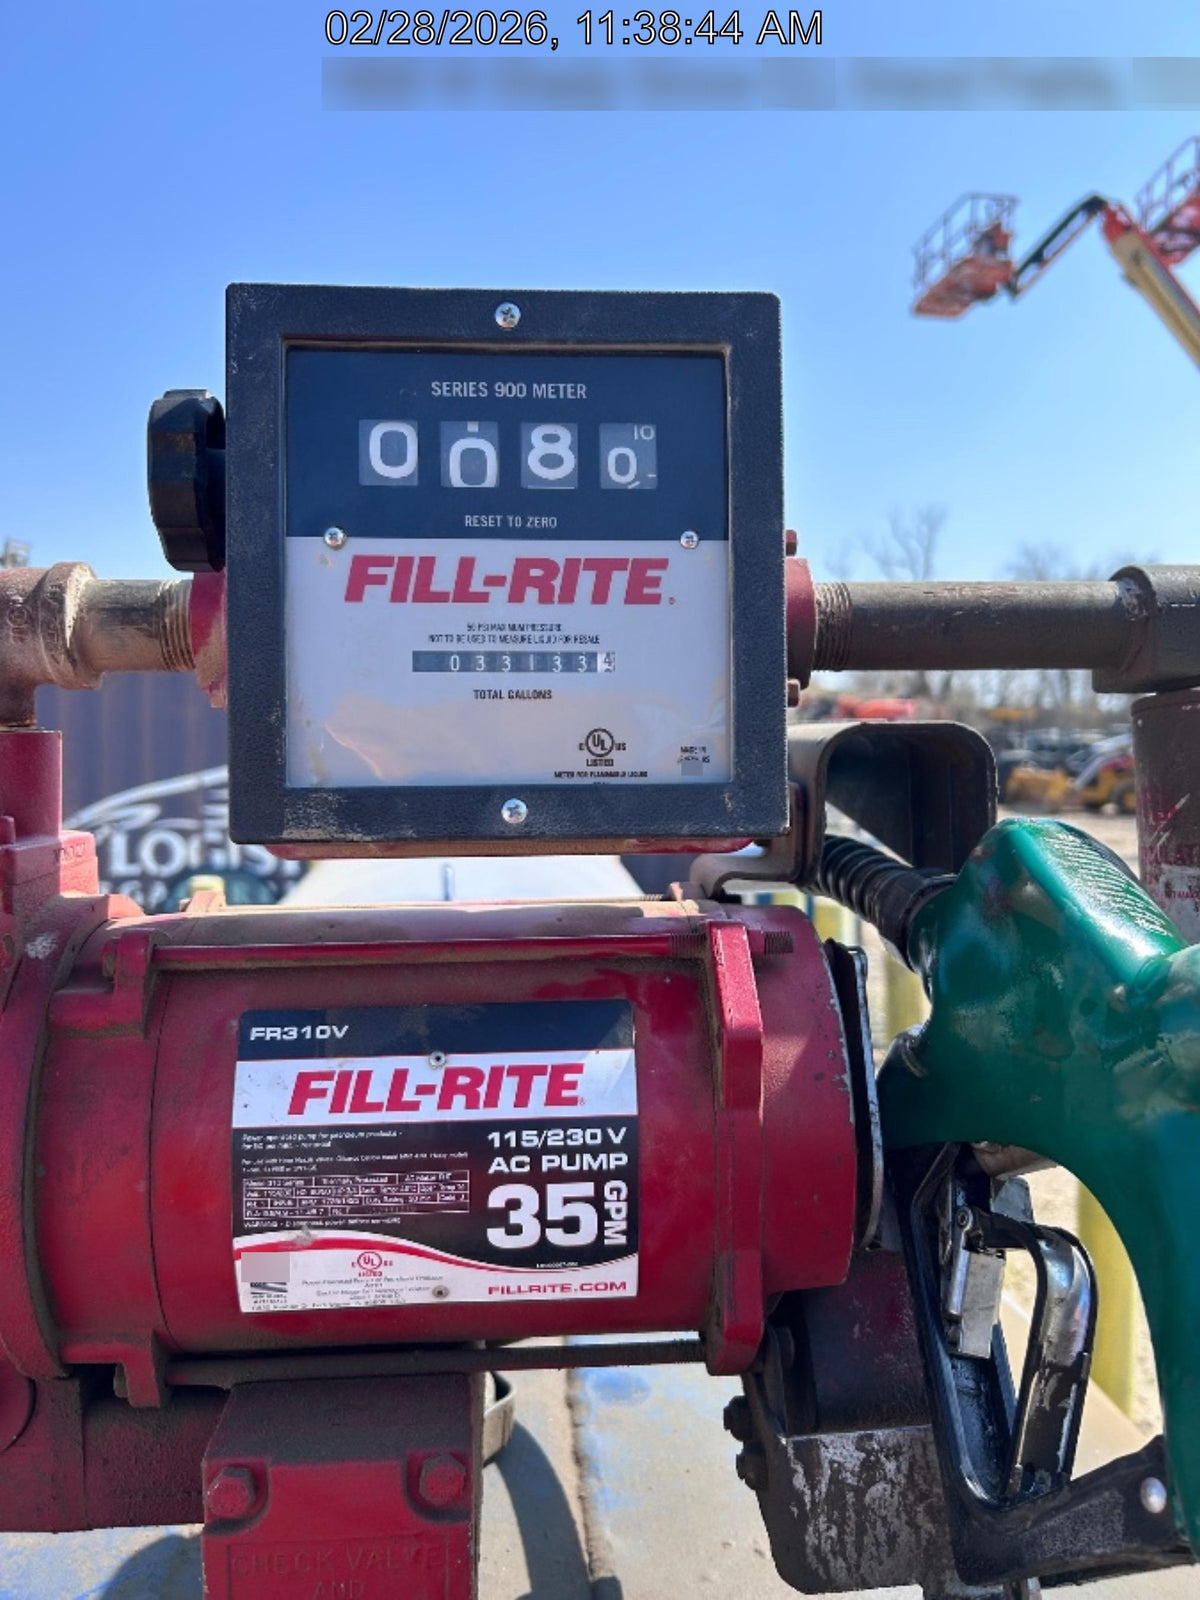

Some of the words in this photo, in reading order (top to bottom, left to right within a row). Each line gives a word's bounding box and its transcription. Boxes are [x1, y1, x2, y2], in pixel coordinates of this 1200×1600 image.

[431, 381, 488, 398] SERIES
[495, 381, 527, 398] 900
[532, 383, 587, 399] METER
[464, 514, 502, 528] RESET
[508, 515, 523, 528] TO
[526, 515, 558, 529] ZERO
[344, 554, 670, 605] FILL-RITE
[473, 689, 503, 700] TOTAL
[507, 689, 553, 700] GALLONS
[586, 758, 614, 767] LISTED
[249, 1024, 349, 1042] FR310V
[287, 1062, 585, 1116] FILL-RITE
[487, 1127, 603, 1149] 115/230
[606, 1126, 628, 1145] V
[488, 1154, 531, 1175] AC
[541, 1152, 629, 1173] PUMP
[486, 1181, 599, 1249] 35
[603, 1180, 629, 1246] GPM
[487, 1280, 628, 1296] FILLRITE.COM
